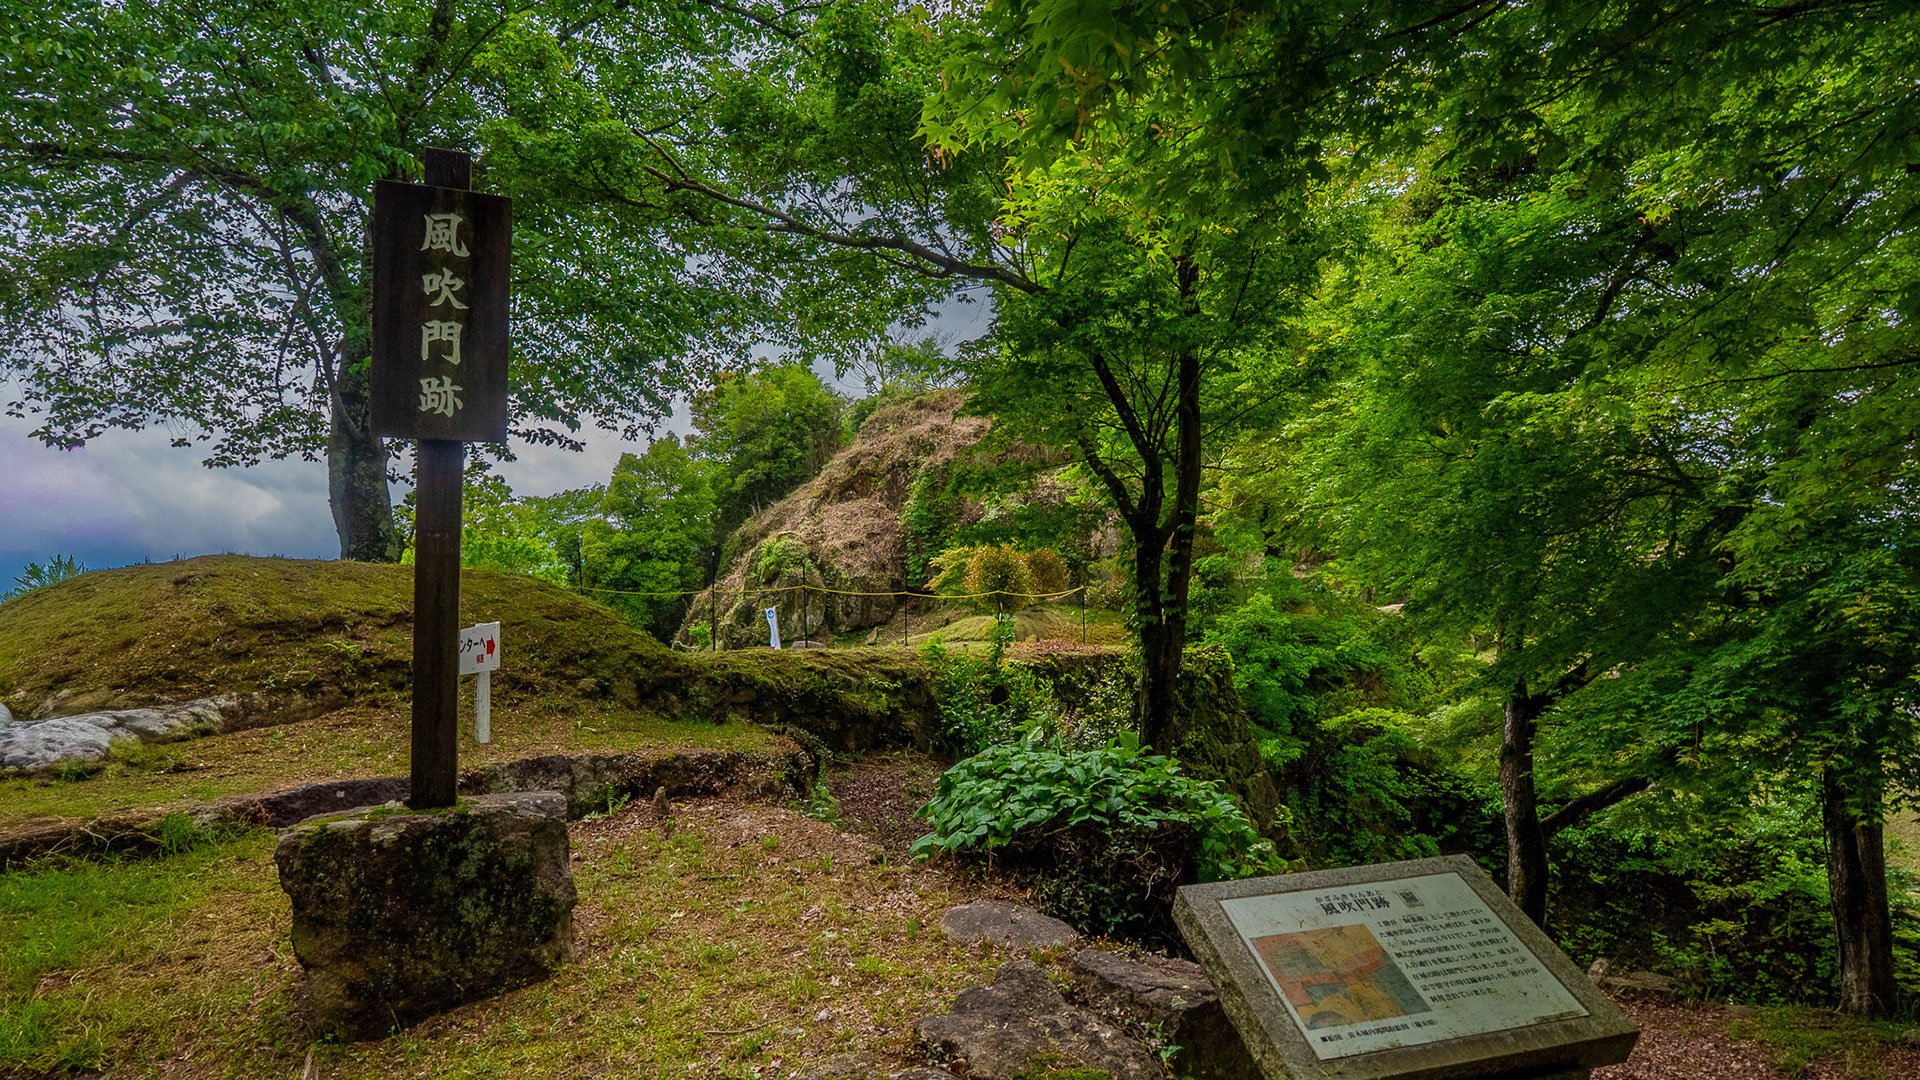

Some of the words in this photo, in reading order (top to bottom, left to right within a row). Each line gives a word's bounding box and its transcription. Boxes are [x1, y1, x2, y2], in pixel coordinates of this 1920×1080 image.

[417, 212, 471, 418] 風吹門跡
[1320, 896, 1391, 915] 風吹門跡
